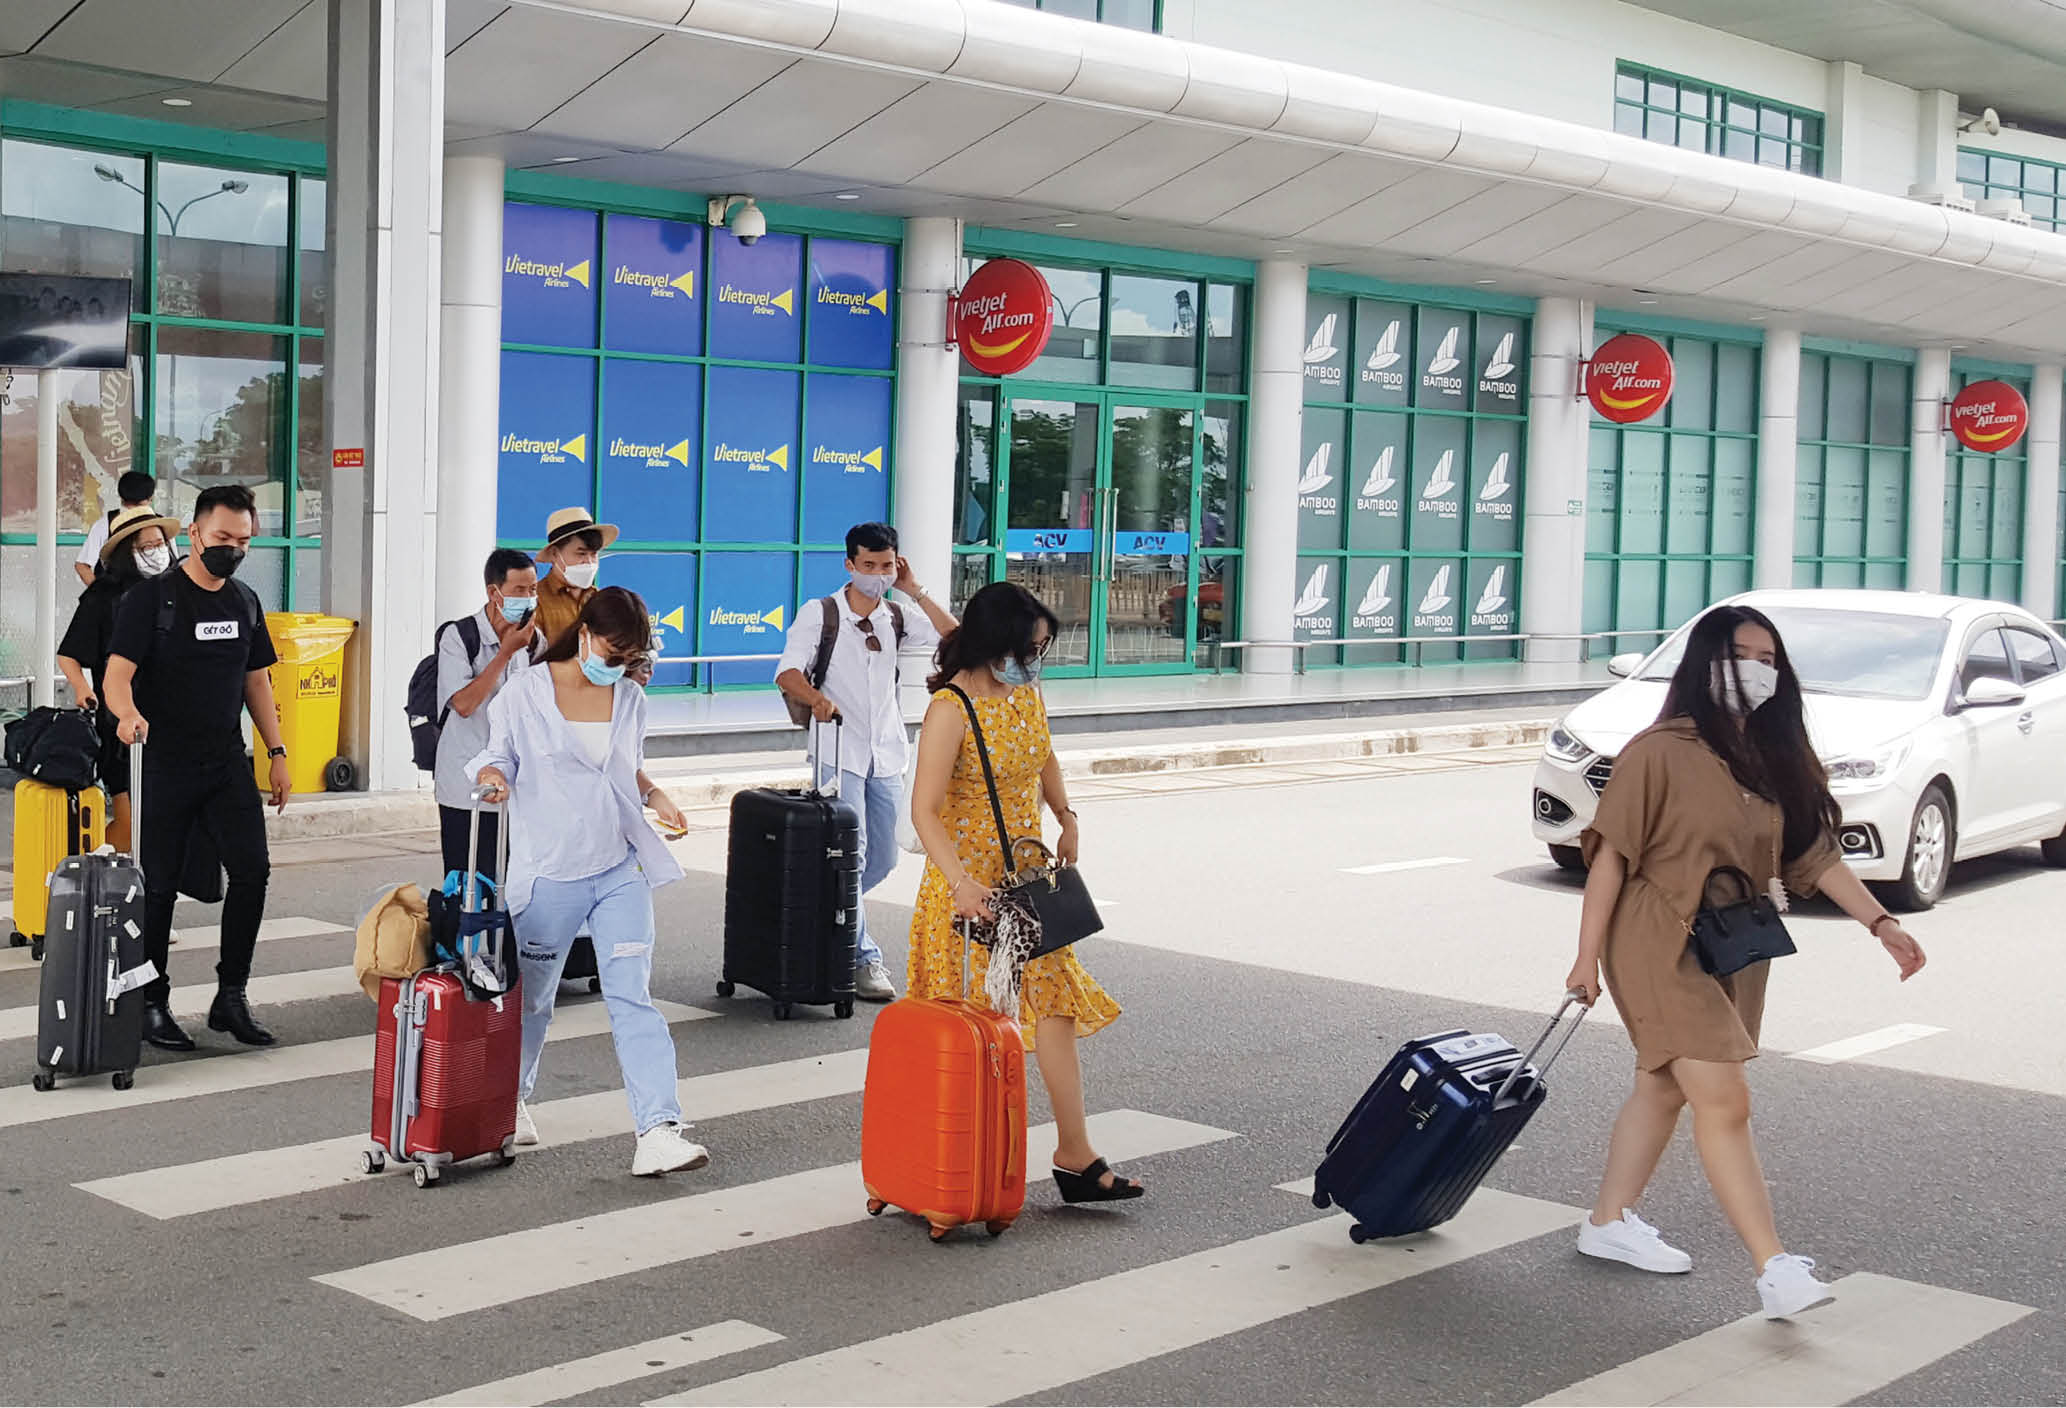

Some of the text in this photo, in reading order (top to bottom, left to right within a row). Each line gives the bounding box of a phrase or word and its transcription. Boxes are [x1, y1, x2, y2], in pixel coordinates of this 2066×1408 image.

[505, 254, 564, 278] Vietravel
[614, 265, 669, 287] Vietravel
[719, 284, 770, 306] Vietravel
[817, 285, 866, 306] Vietravel
[1303, 365, 1341, 379] AMBOO
[1362, 370, 1403, 385] BAMBOO
[1423, 375, 1462, 389] BAMBOO
[1480, 380, 1517, 394] BAMBOO
[501, 433, 559, 454] Vietravel
[610, 437, 665, 458] Vietravel
[714, 443, 766, 463] Vietravel
[813, 445, 861, 464] Vietravel
[1299, 496, 1336, 509] AMBOO
[1357, 498, 1399, 511] BAMBOO
[1418, 501, 1457, 513] BAMBOO
[1475, 503, 1512, 514] BAMBOO
[1033, 533, 1068, 549] ACV
[1133, 535, 1166, 551] ACV
[709, 606, 761, 625] Vietravel
[1295, 616, 1332, 629] AMBOO
[1352, 615, 1394, 628] BAMBOO
[1414, 615, 1453, 627] BAMBOO
[1471, 614, 1508, 626] BAMBOO
